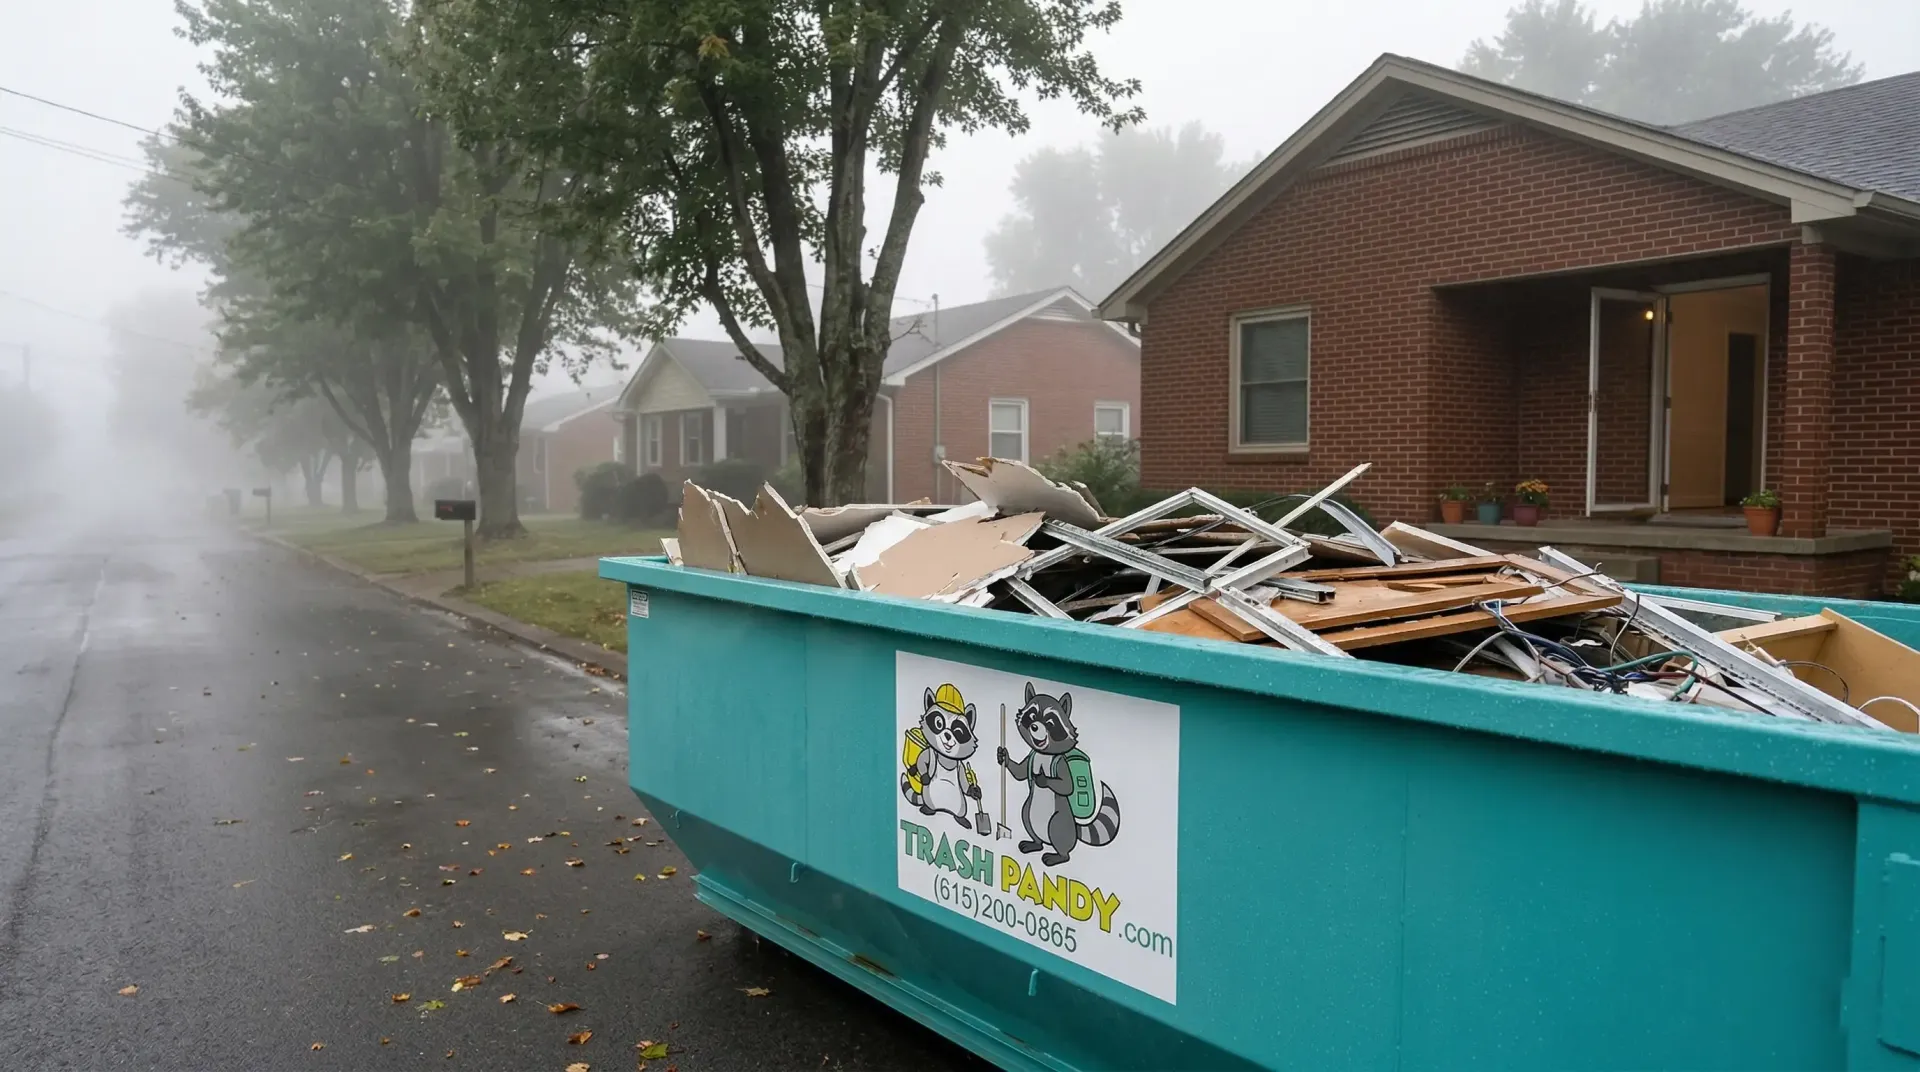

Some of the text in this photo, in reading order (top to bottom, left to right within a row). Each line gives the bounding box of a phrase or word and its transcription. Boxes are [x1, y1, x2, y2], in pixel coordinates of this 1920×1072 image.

[900, 819, 1173, 958] TRASH PANDY .com
[933, 874, 1077, 953] (615)200-0865
